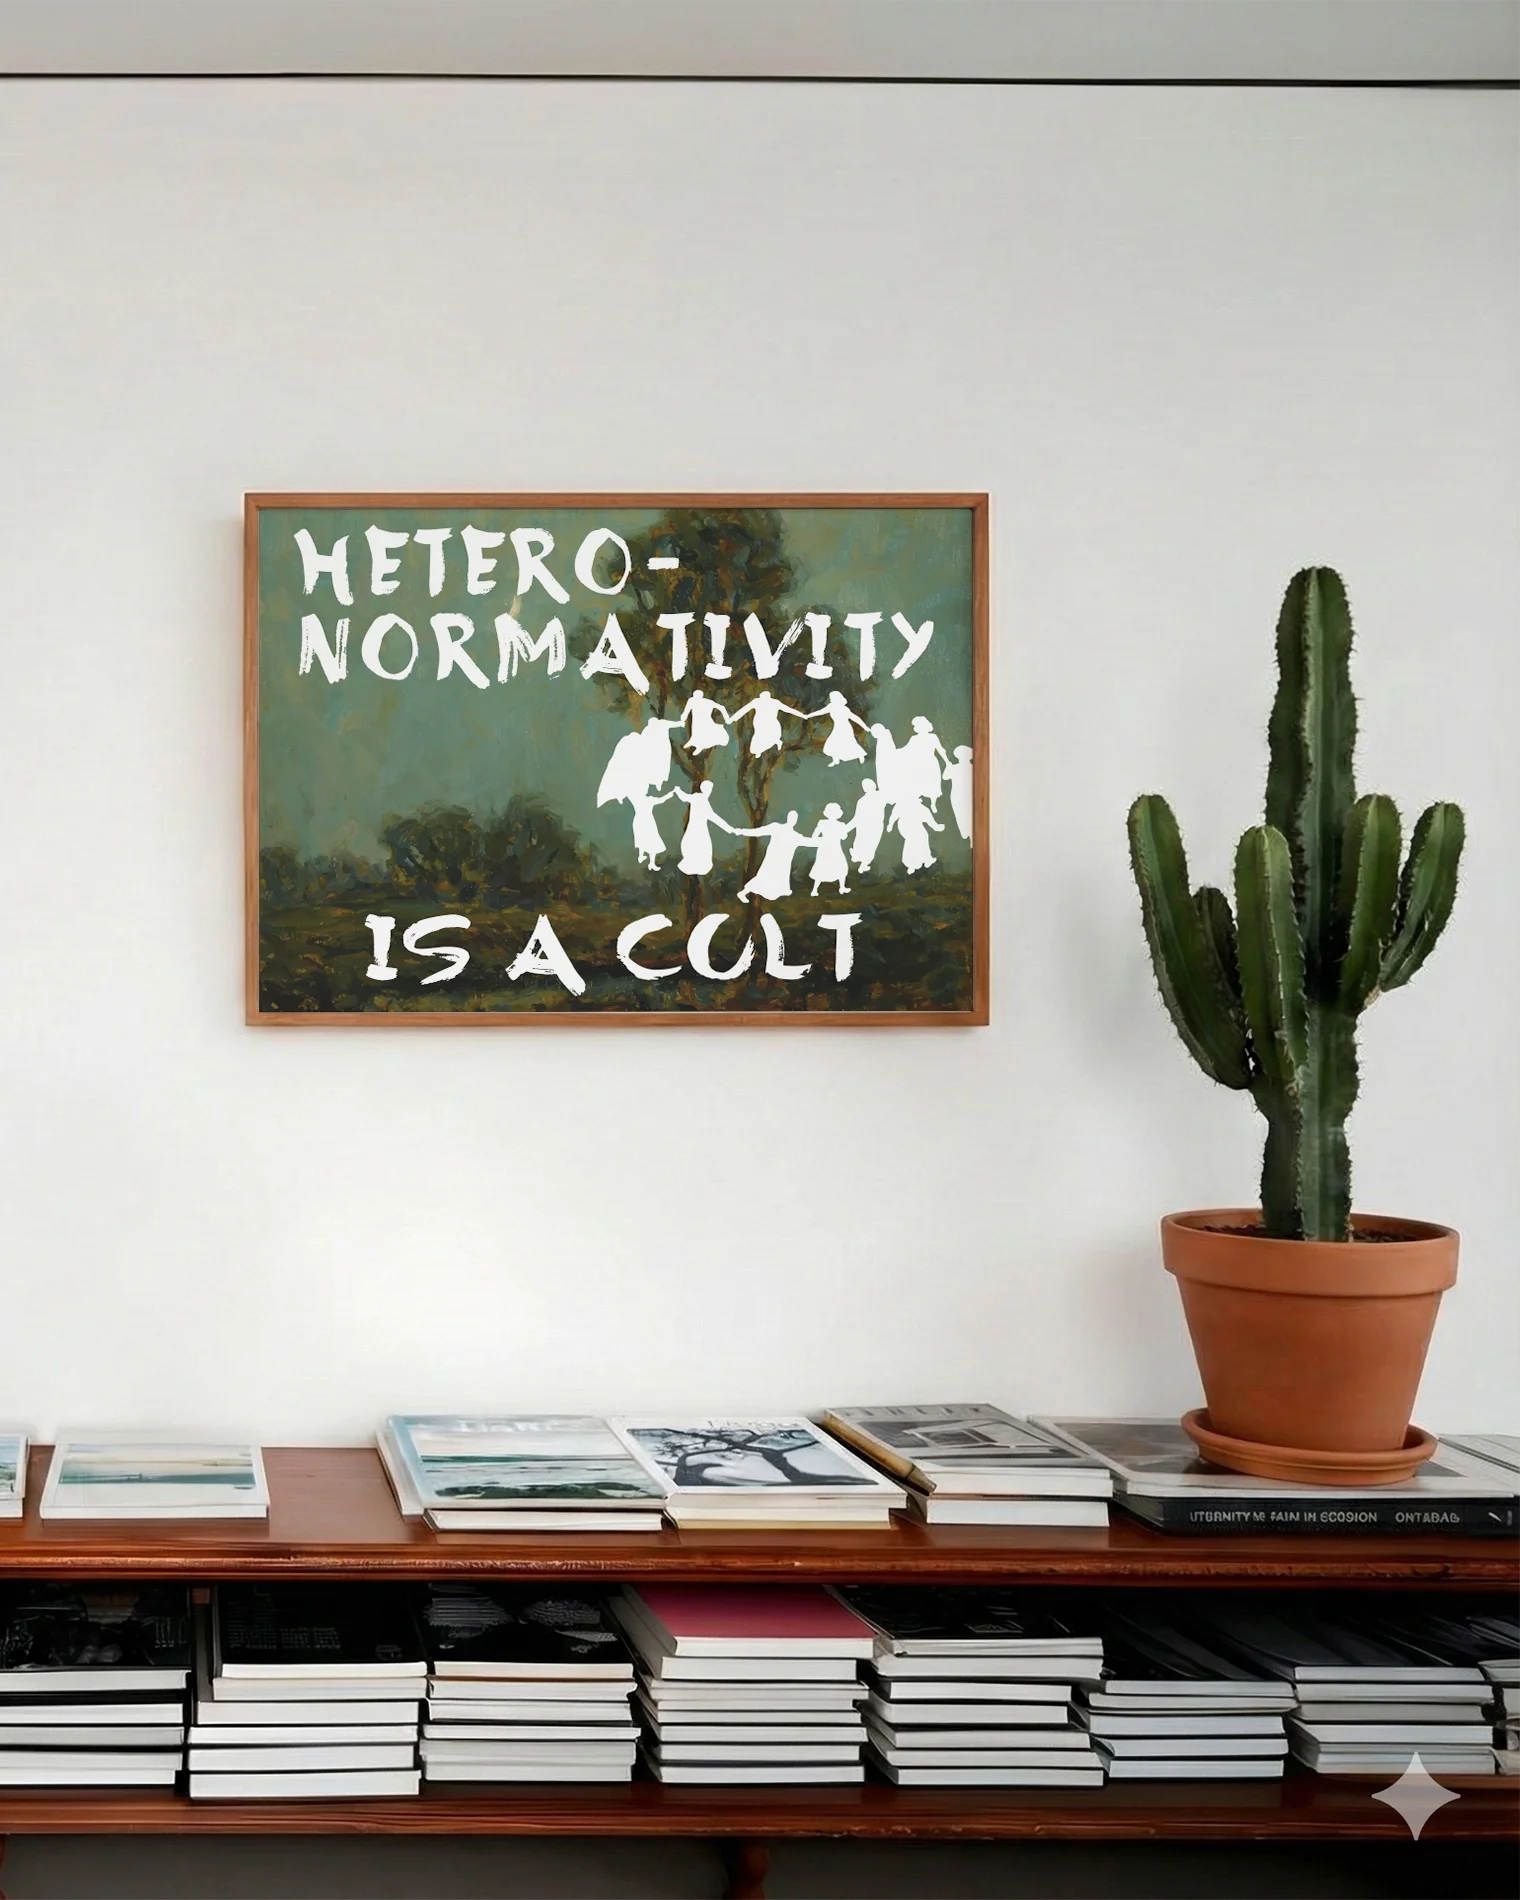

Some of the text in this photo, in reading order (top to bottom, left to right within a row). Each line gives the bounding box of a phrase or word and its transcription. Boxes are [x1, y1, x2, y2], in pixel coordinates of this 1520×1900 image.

[294, 525, 679, 605] HETERO-
[299, 612, 933, 696] NORMATIVITY
[365, 913, 861, 995] IS A CULT
